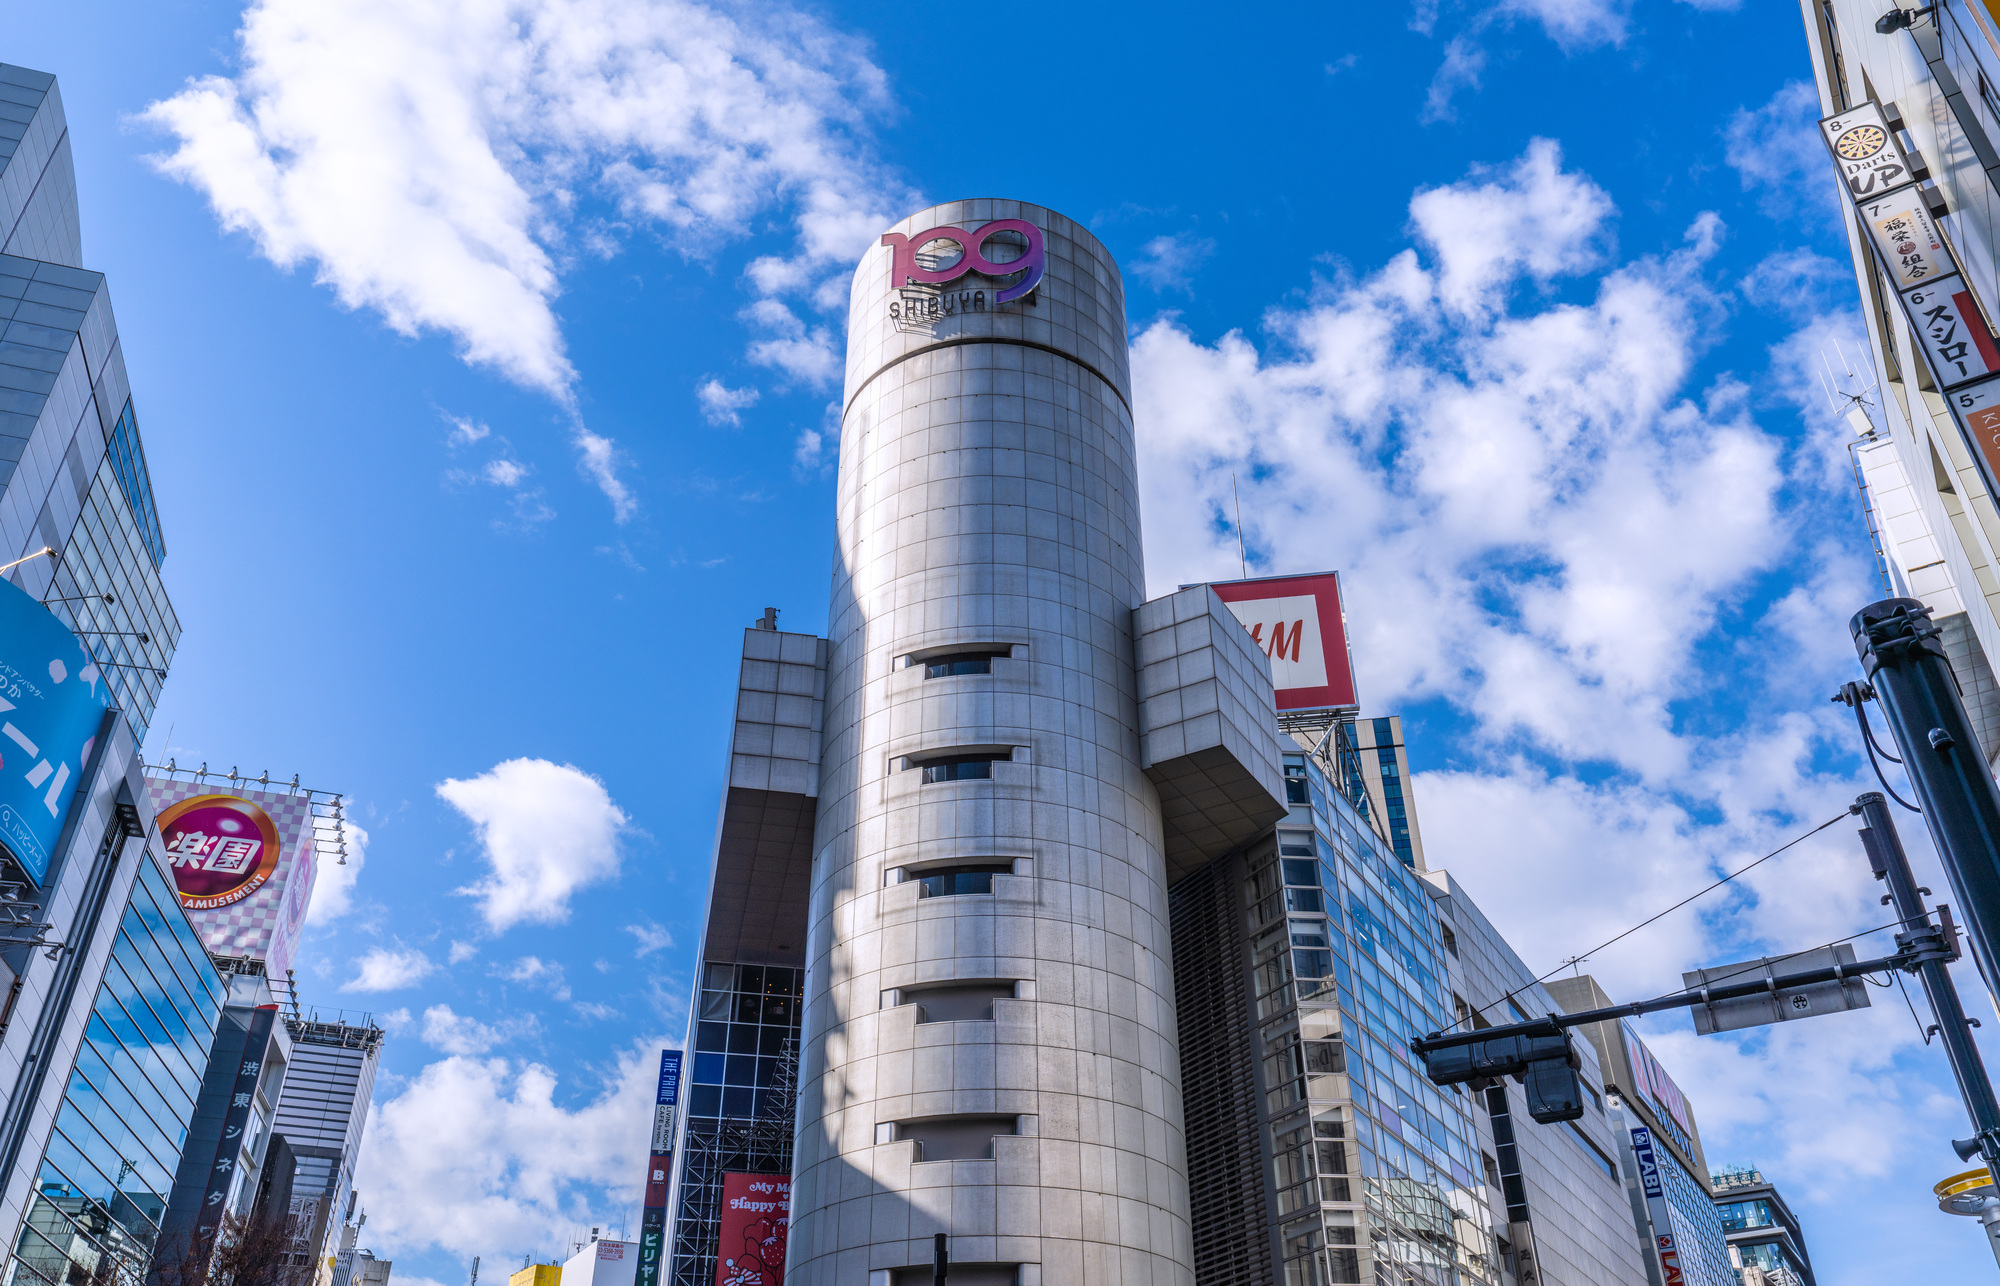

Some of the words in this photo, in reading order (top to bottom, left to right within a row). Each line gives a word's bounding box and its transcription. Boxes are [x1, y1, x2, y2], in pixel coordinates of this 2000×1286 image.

[1847, 152, 1896, 175] Darts
[1849, 164, 1904, 194] UP
[881, 219, 1044, 304] 109
[889, 291, 985, 319] SHIBUYA
[1922, 305, 1968, 377] スシロー
[0, 695, 70, 819] ール
[12, 823, 42, 866] ハッピーメール
[165, 831, 262, 875] 楽園
[184, 873, 266, 909] AMUSEMENT
[663, 1057, 679, 1073] THE
[660, 1074, 676, 1102] PRIME
[1640, 1041, 1693, 1141] LABI
[658, 1105, 666, 1124] CAFE
[664, 1106, 672, 1128] LIVING
[662, 1129, 670, 1149] ROOM
[653, 1169, 665, 1181] B
[1637, 1149, 1661, 1194] LABI
[749, 1181, 775, 1195] My
[730, 1196, 777, 1213] Happy
[1661, 1251, 1685, 1286] LA
